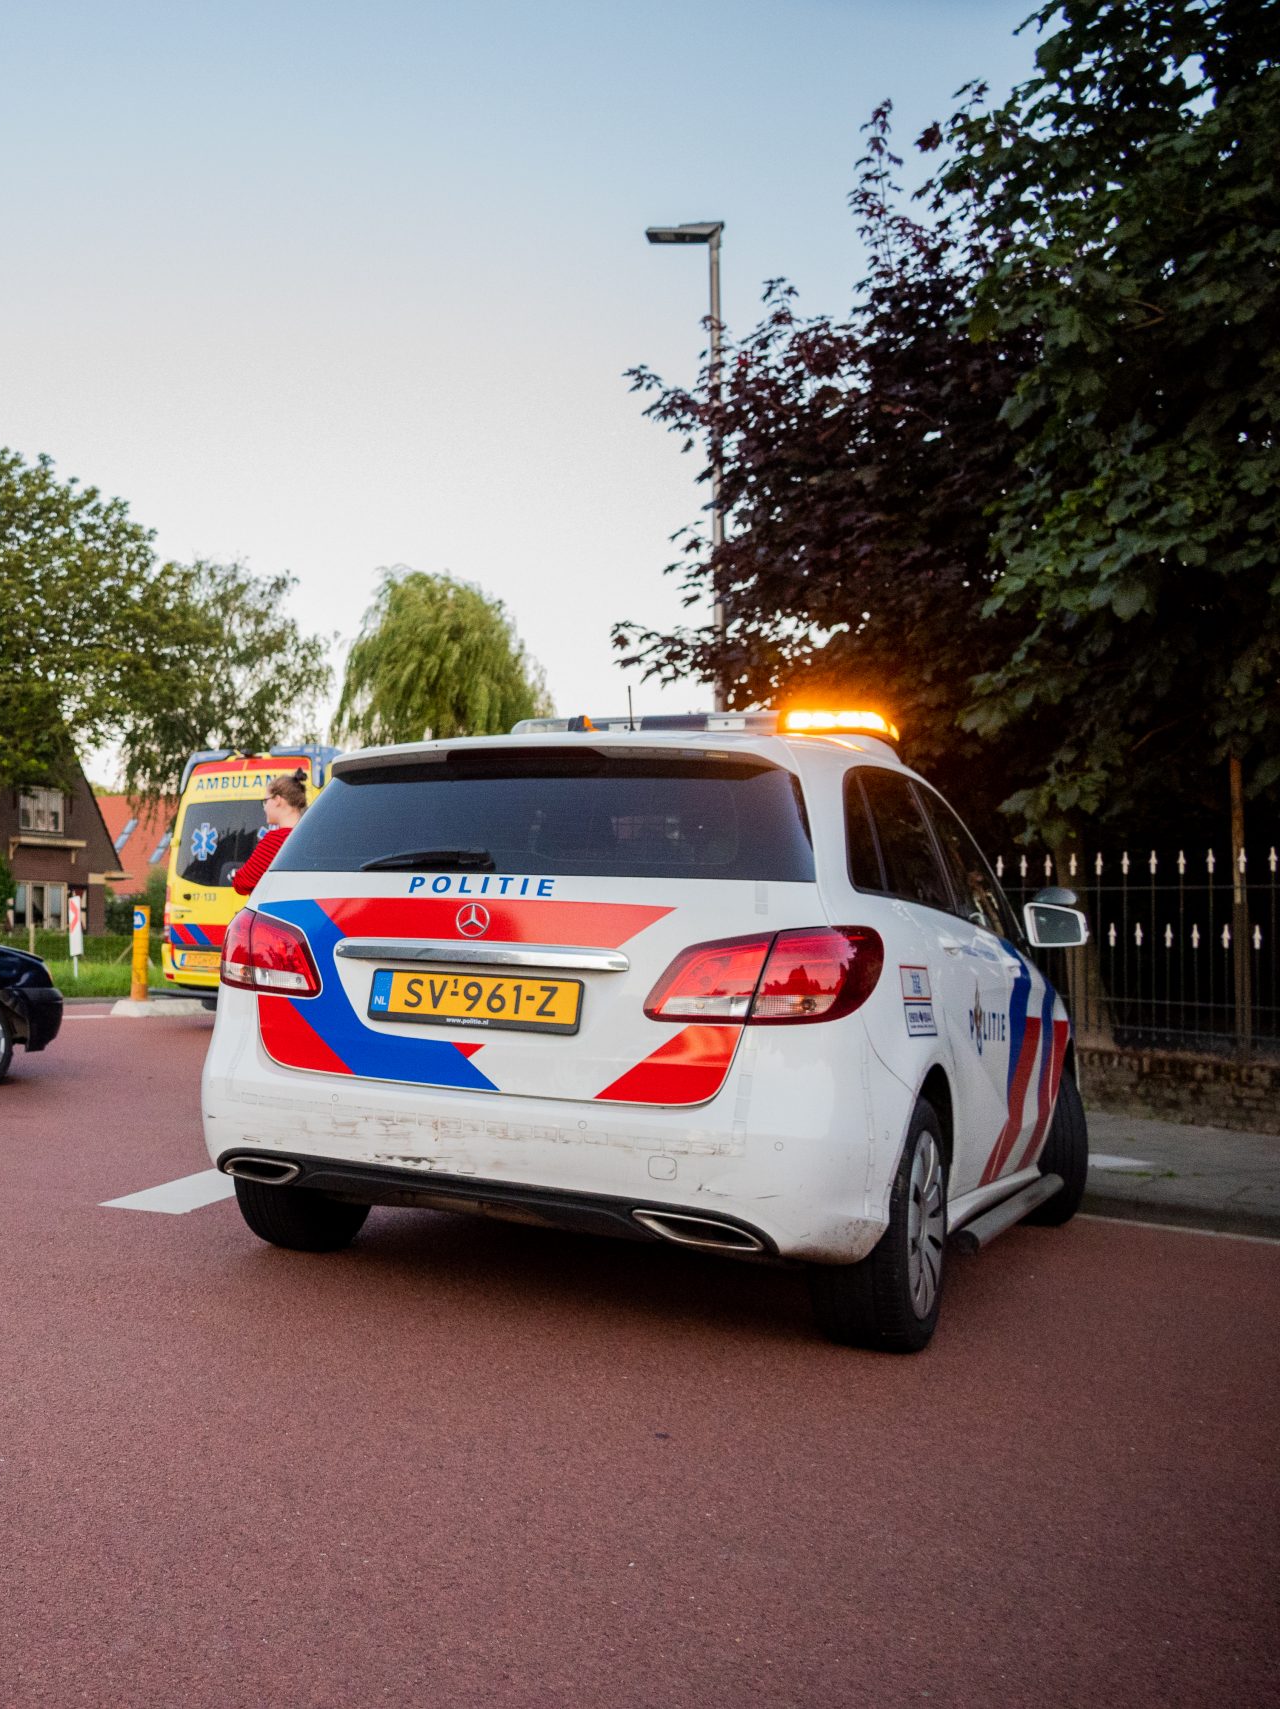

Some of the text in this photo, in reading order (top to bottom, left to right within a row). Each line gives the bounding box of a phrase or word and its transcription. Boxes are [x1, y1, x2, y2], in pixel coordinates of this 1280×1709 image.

[196, 774, 277, 790] AMBULAN
[408, 876, 555, 897] POLITIE
[373, 995, 387, 1005] NL
[446, 1017, 489, 1026] www.politie.nl
[969, 1010, 1006, 1042] PLITIE
